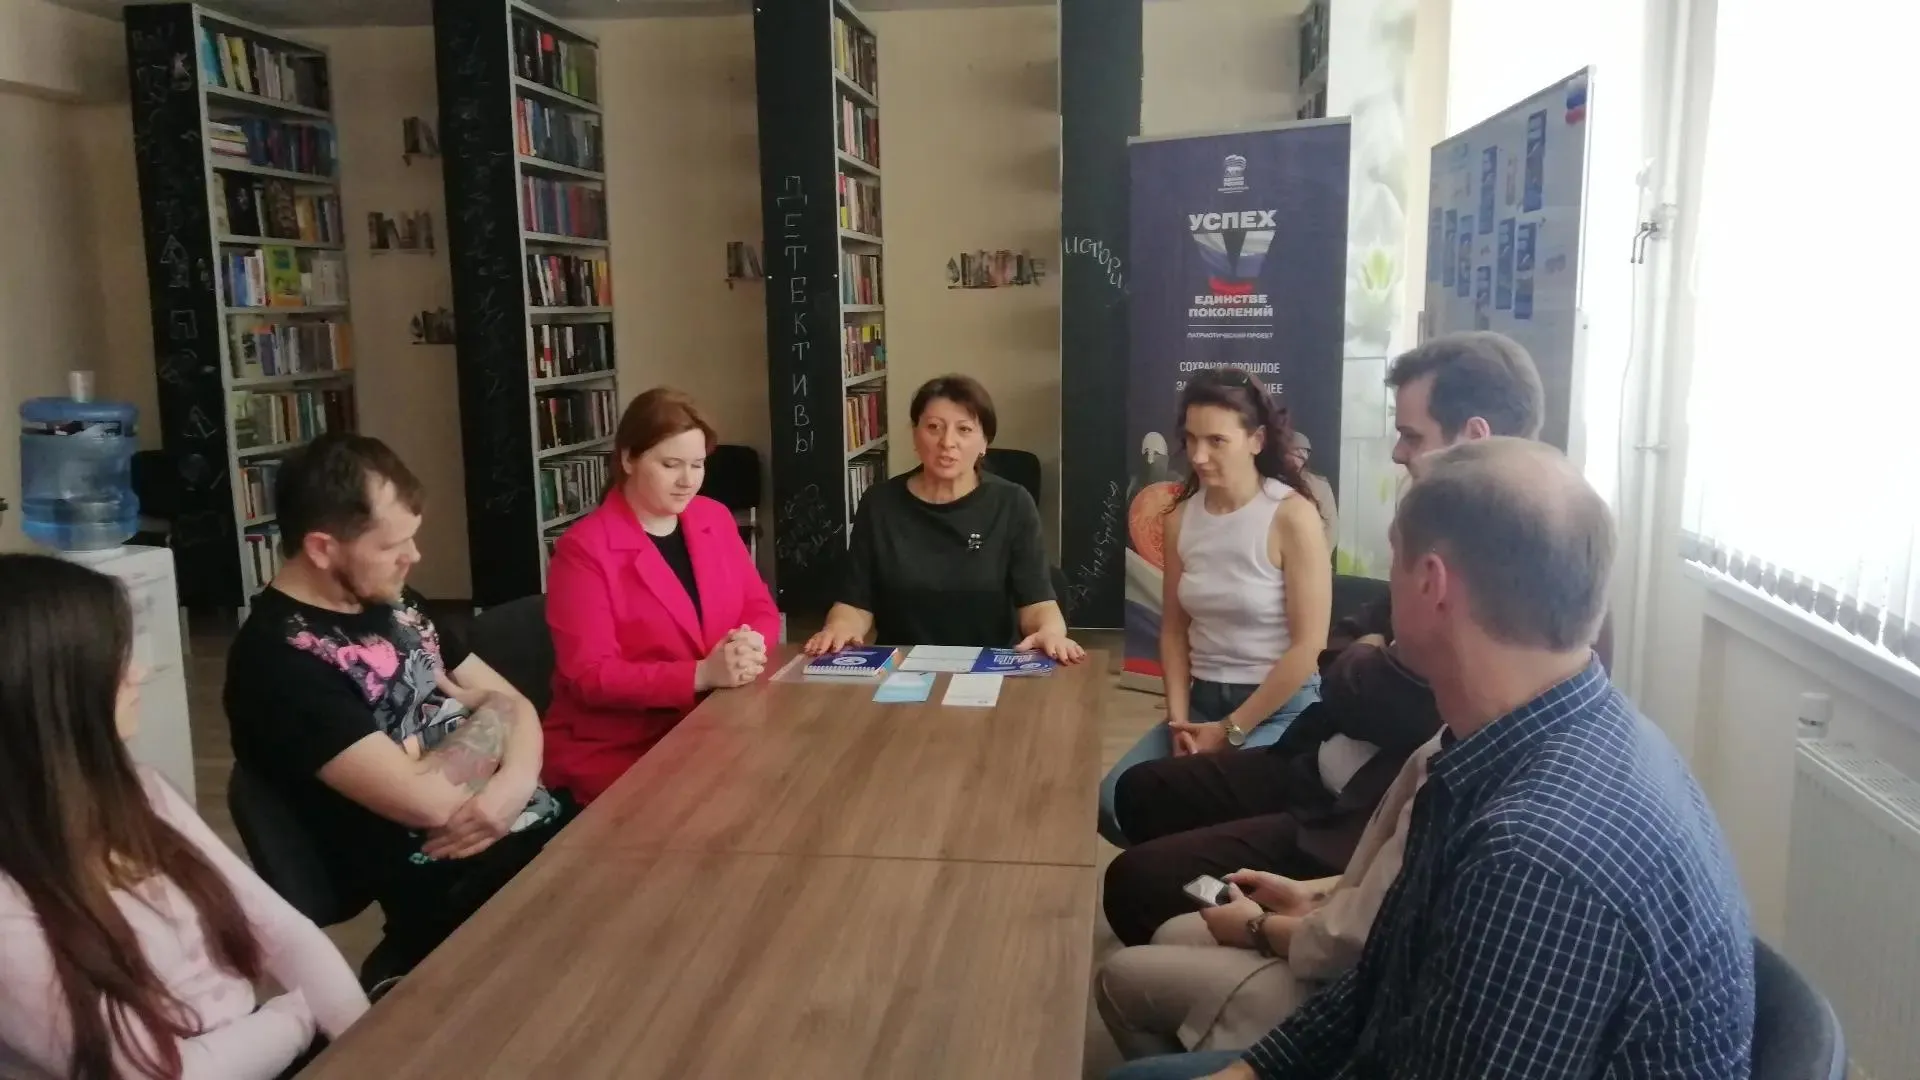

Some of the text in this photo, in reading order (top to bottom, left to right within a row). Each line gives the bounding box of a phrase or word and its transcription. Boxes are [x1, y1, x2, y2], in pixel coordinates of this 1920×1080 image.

[1188, 210, 1277, 231] УСПЕХ
[1194, 294, 1268, 305] ЕДИНСТВЕ
[1188, 305, 1273, 317] ПОКОЛЕНИЙ
